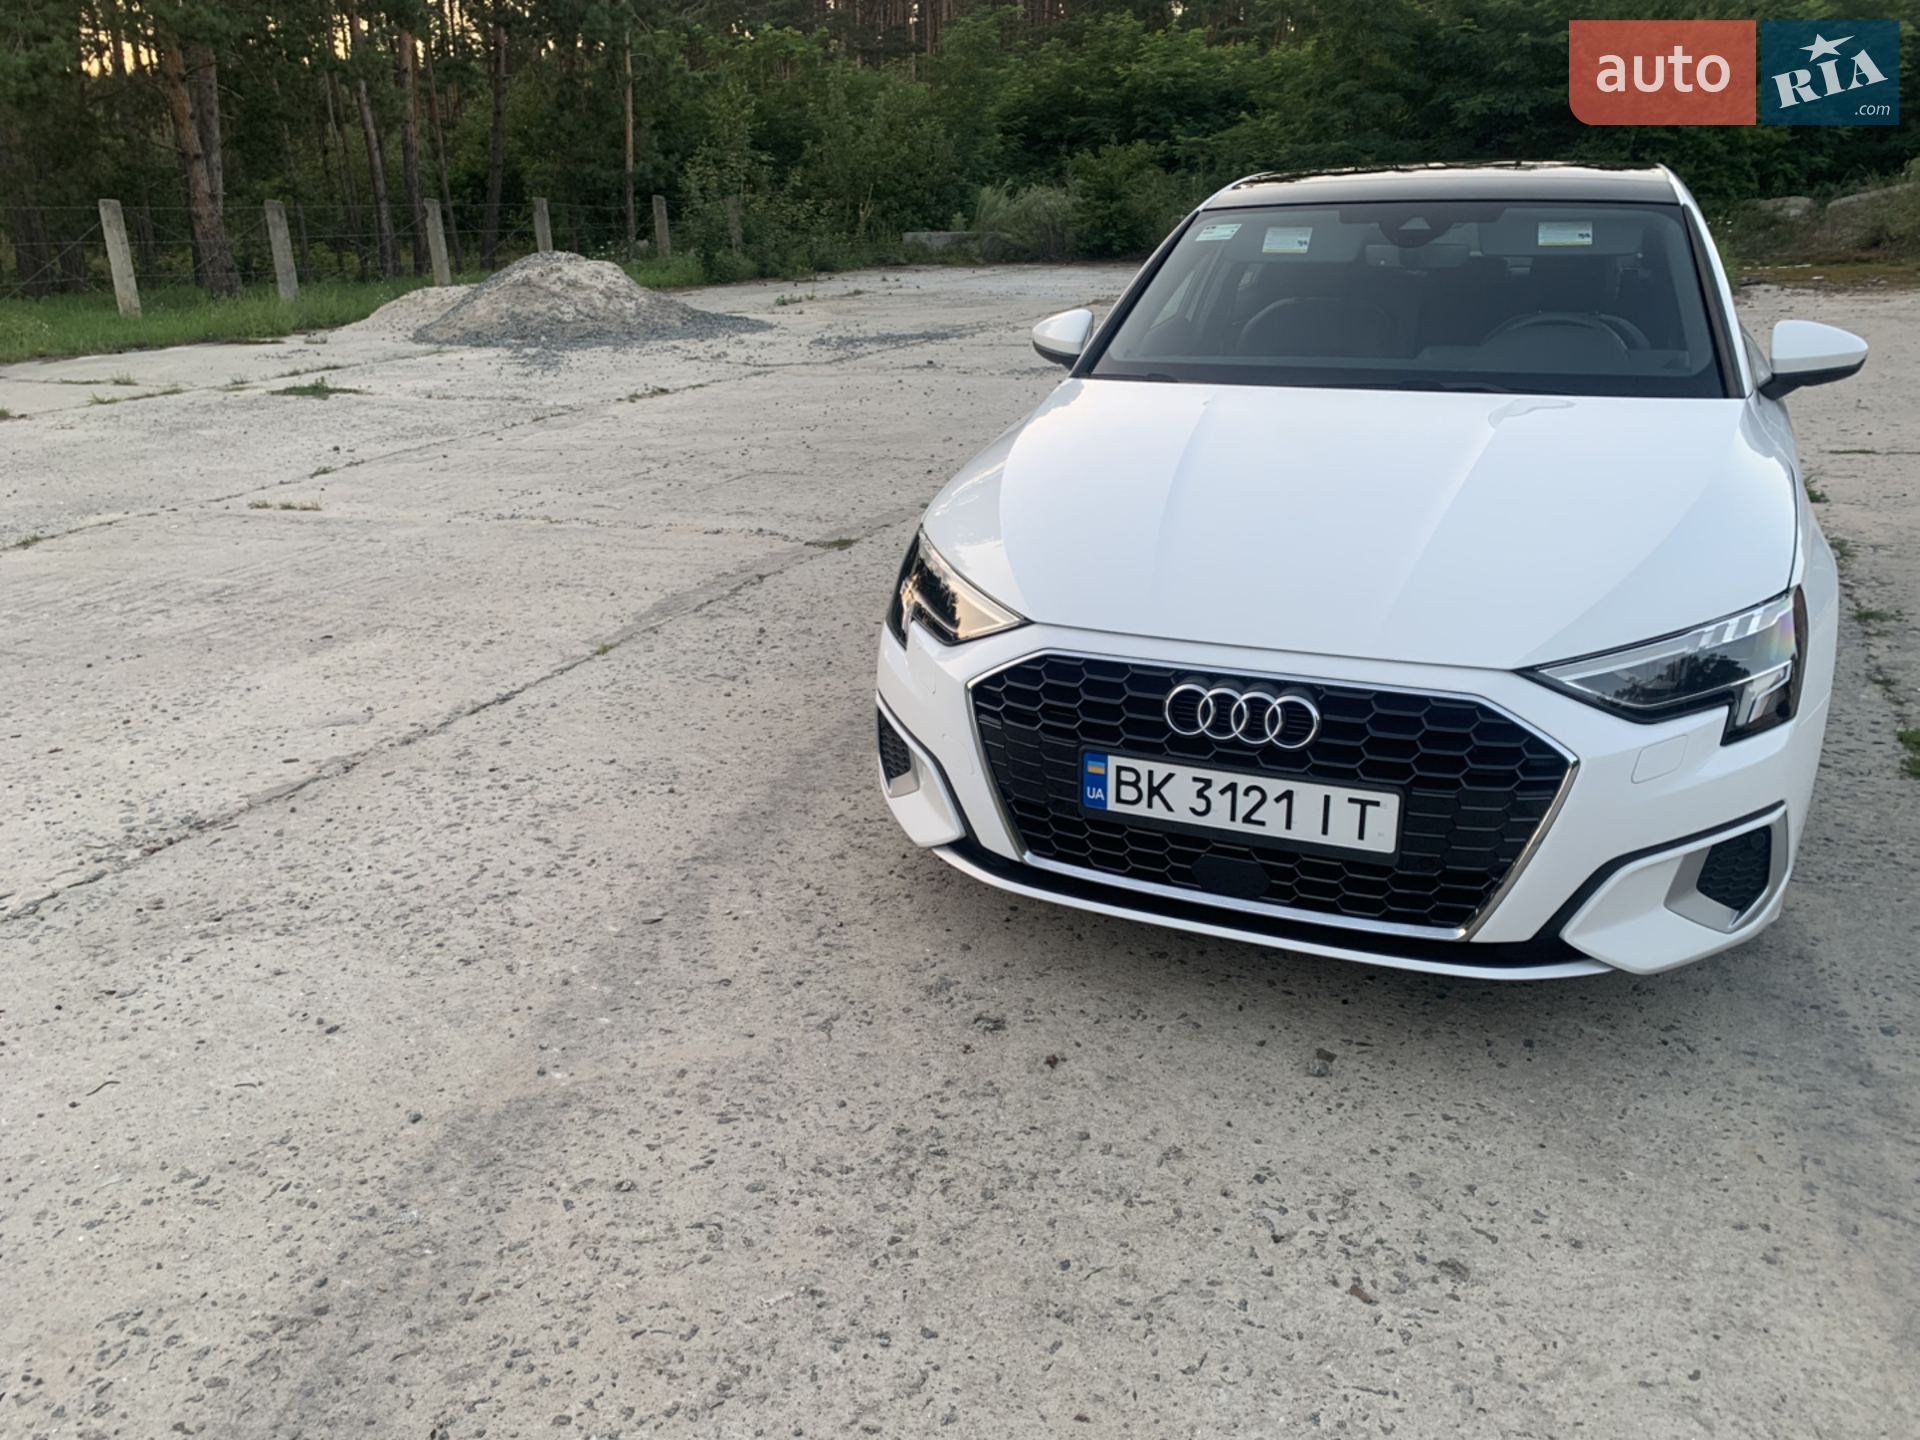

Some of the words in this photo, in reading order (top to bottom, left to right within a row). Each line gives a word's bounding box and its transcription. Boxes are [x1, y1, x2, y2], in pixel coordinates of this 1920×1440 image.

[1086, 786, 1105, 801] UA
[1114, 764, 1176, 813] BK
[1188, 776, 1295, 831] 3121
